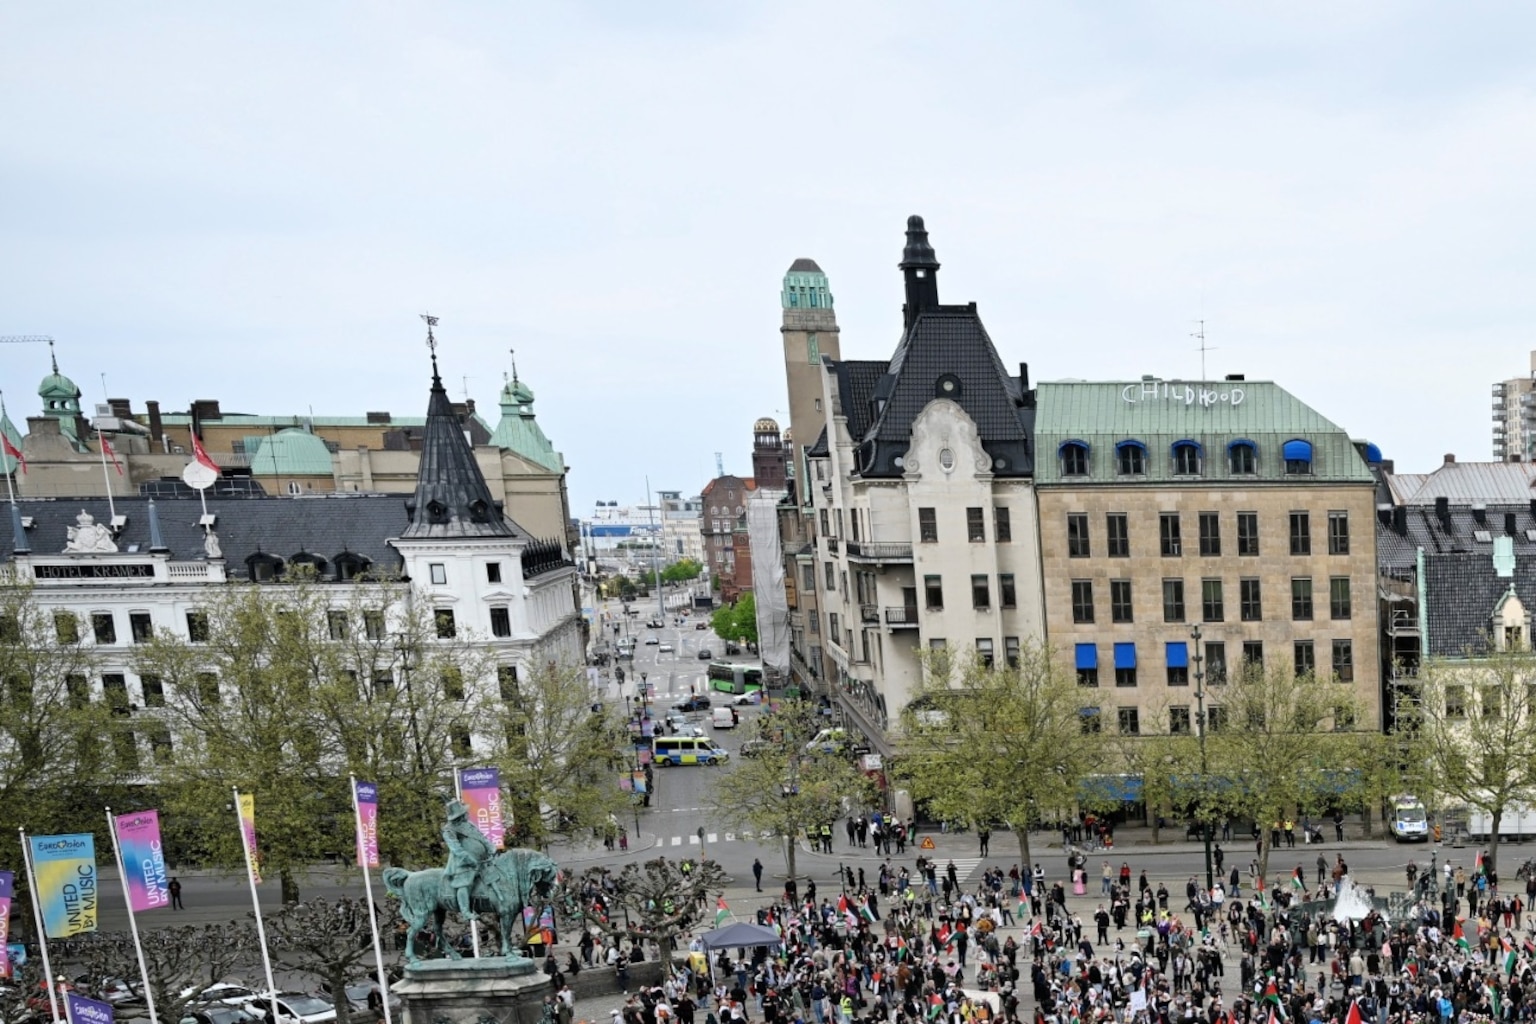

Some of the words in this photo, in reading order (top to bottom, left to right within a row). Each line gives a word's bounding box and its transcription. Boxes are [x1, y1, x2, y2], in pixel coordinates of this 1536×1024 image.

[1122, 382, 1245, 407] CHILDHOOD
[42, 565, 88, 578] HOTEL
[92, 564, 147, 577] KRAMER
[487, 793, 501, 827] MUSIC
[150, 839, 167, 883] MUSIC
[77, 864, 95, 911] MUSIC
[142, 859, 160, 905] UNITED
[157, 887, 168, 902] BY
[62, 883, 82, 933] UNITED
[83, 915, 94, 929] BY
